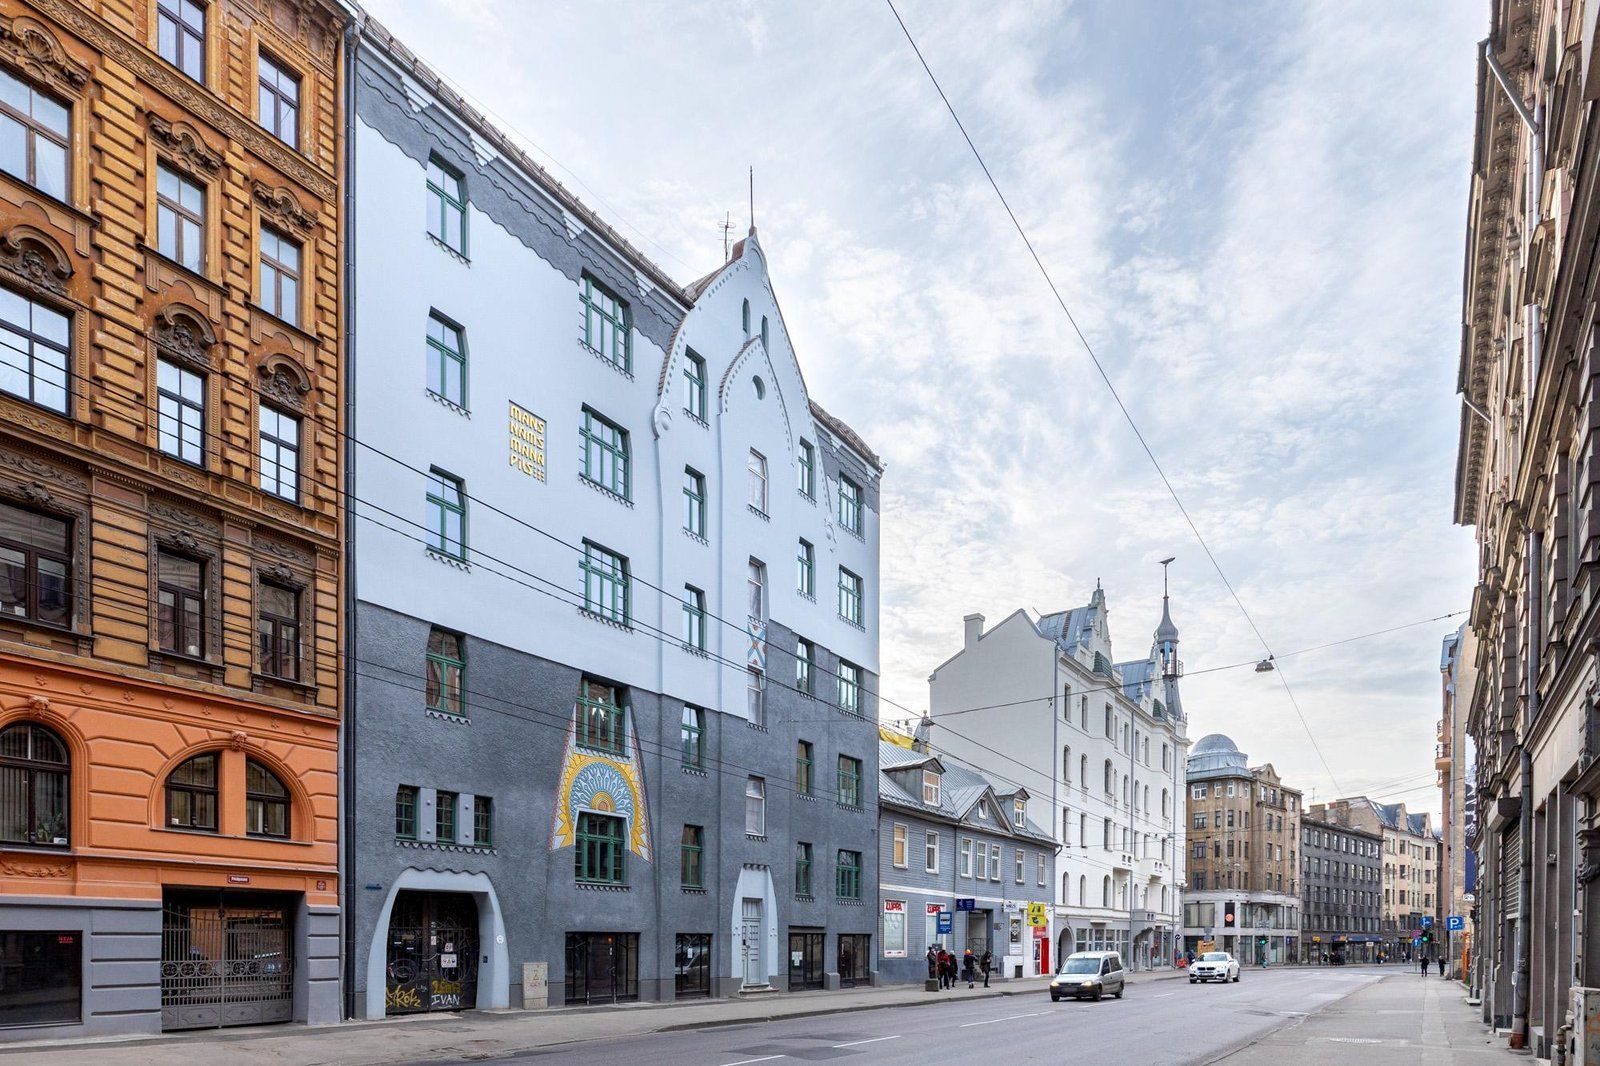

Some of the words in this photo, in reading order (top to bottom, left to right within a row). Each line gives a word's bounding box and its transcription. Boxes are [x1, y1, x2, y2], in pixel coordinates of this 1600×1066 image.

[510, 421, 544, 450] NAMS
[1450, 918, 1459, 929] P
[431, 993, 460, 1006] IVAN
